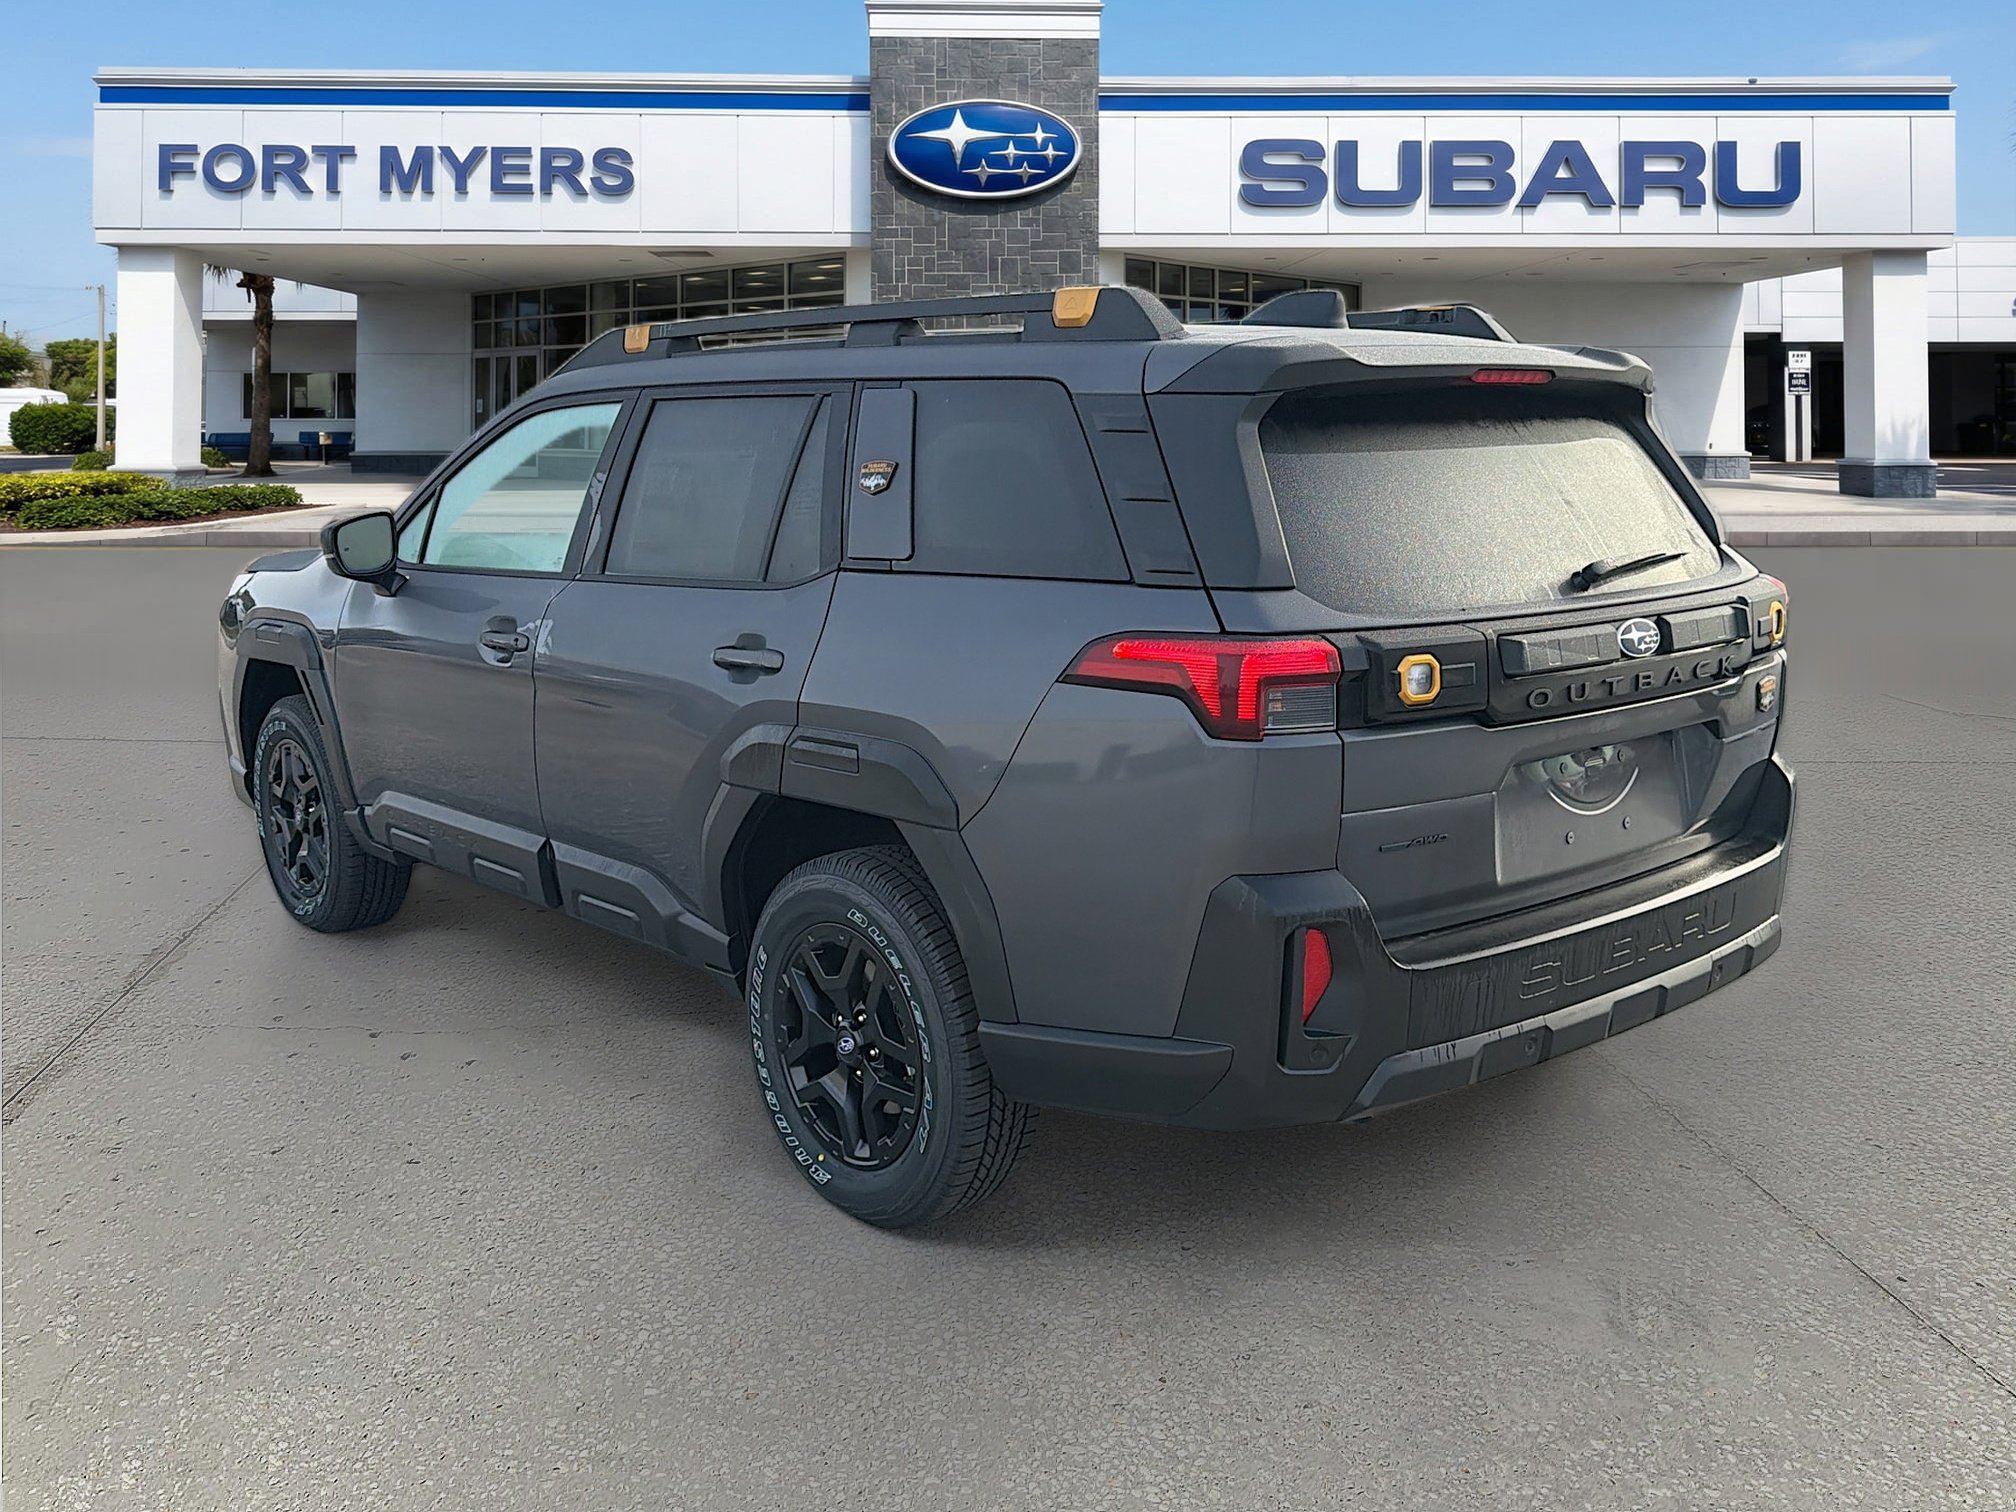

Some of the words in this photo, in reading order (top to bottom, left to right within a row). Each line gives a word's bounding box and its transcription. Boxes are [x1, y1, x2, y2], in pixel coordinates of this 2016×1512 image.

[159, 143, 357, 194] FORT
[380, 145, 635, 196] MYERS
[1240, 139, 1801, 208] SUBARU
[1526, 654, 1738, 709] OUTBACK
[847, 908, 932, 1063] DUELER
[1519, 891, 1738, 999] SUBARU
[750, 945, 832, 1185] BRIDGESTONE
